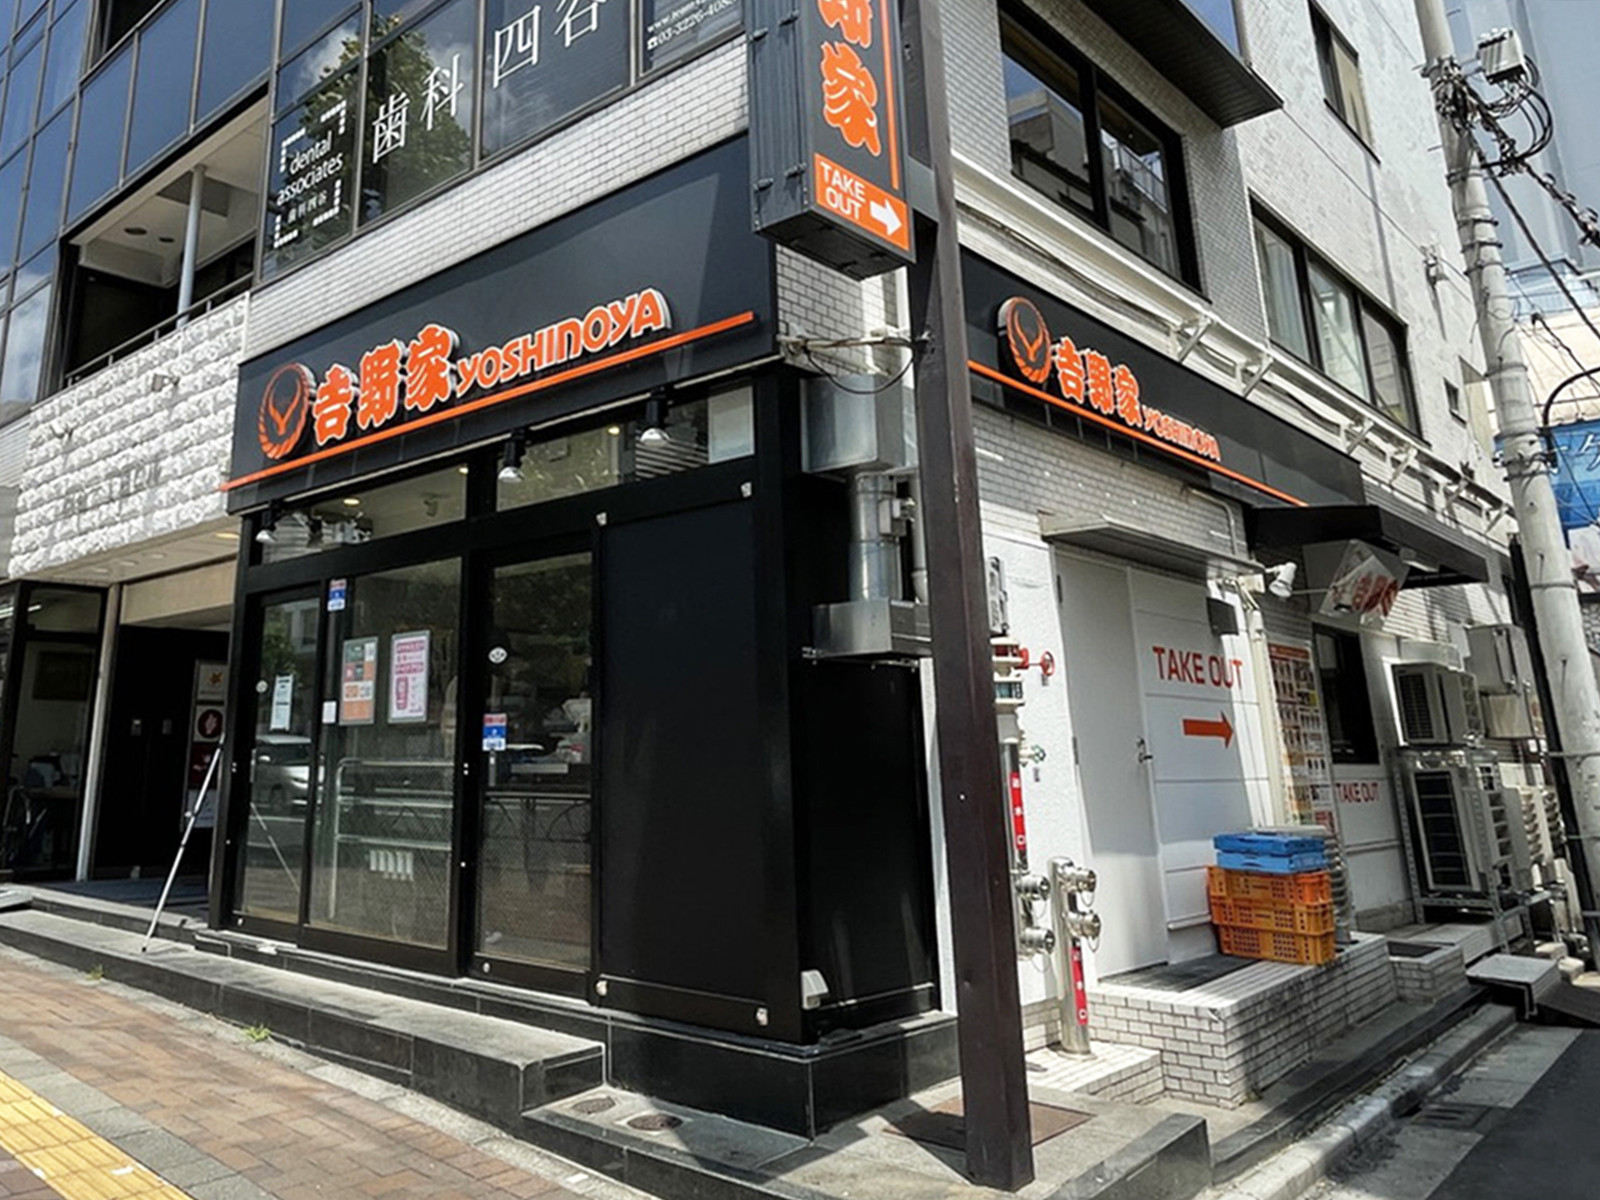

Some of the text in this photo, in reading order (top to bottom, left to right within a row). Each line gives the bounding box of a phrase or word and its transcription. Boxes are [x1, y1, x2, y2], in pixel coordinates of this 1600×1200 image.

[289, 130, 333, 175] dental
[276, 152, 344, 207] associates
[820, 161, 867, 203] TAKE
[825, 187, 863, 220] OUT
[311, 323, 458, 446] 吉野家
[1055, 336, 1143, 427] 吉野家
[1152, 646, 1243, 691] TAKE OUT
[1335, 782, 1380, 804] TAKE OUT
